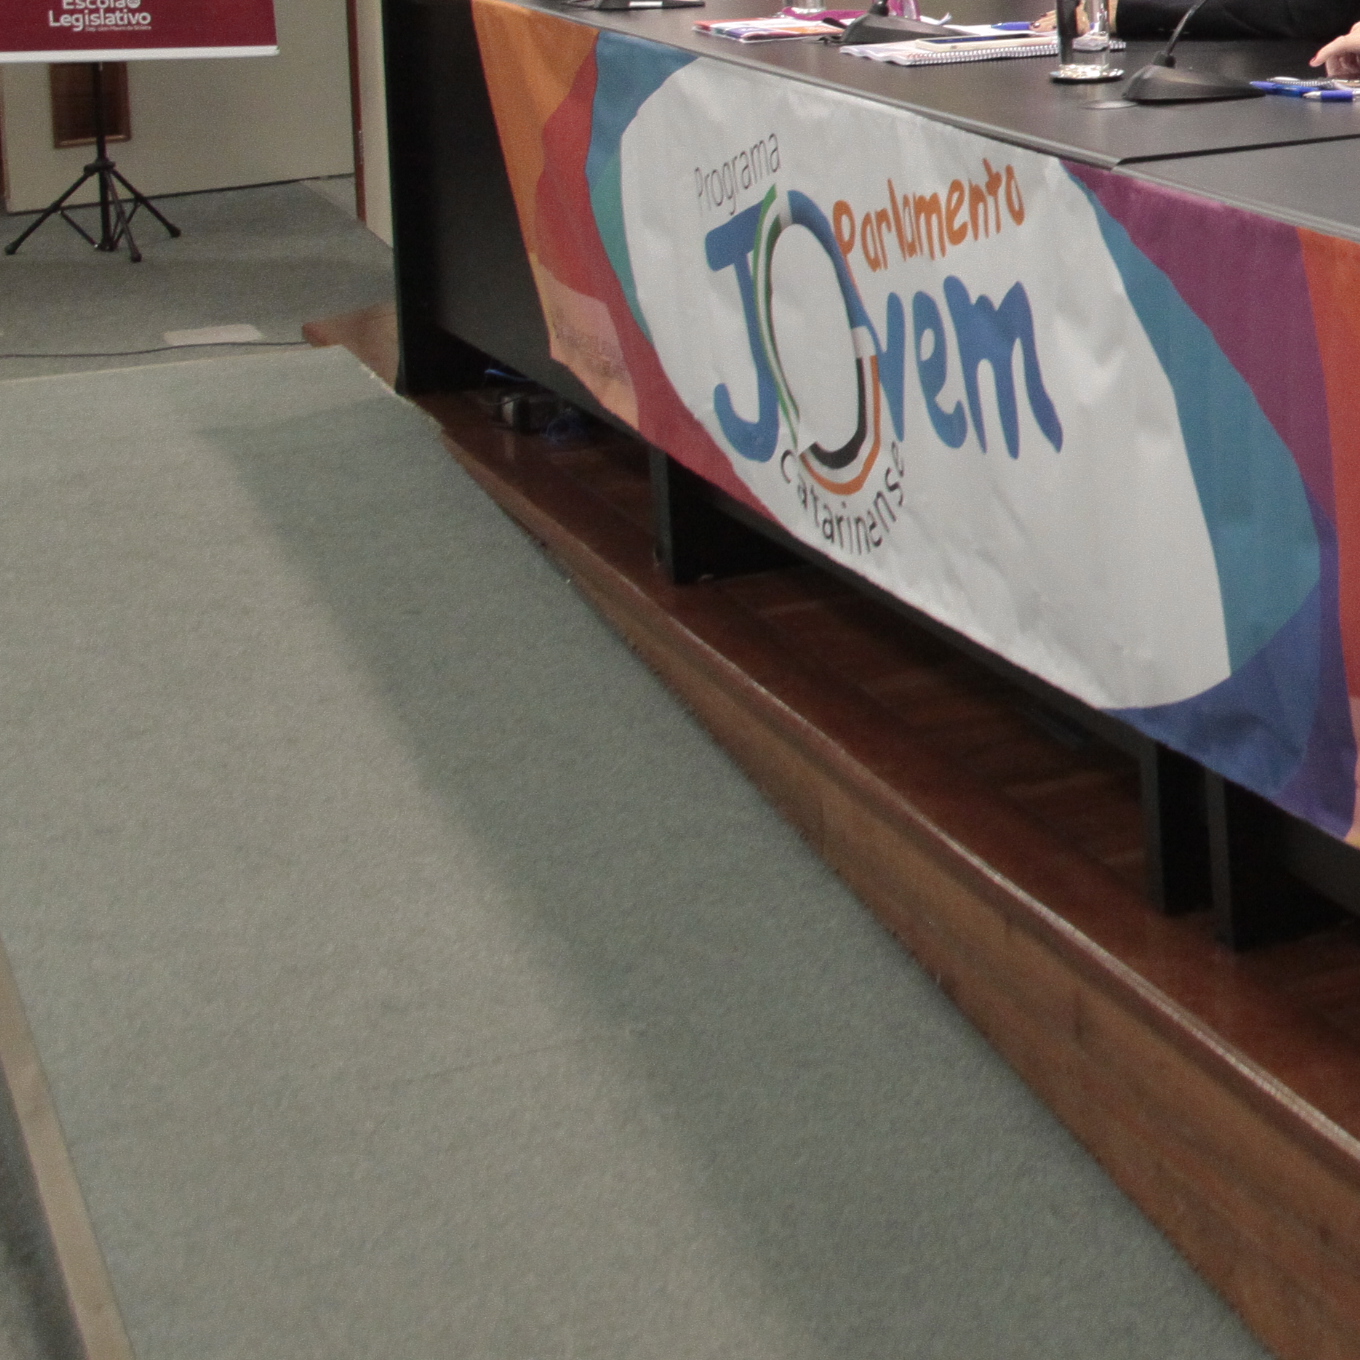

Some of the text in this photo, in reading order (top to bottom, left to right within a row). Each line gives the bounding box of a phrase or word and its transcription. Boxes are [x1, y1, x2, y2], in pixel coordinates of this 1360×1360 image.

[48, 8, 152, 32] Legislativo
[696, 132, 781, 216] Programa
[832, 157, 1025, 275] Parlamento
